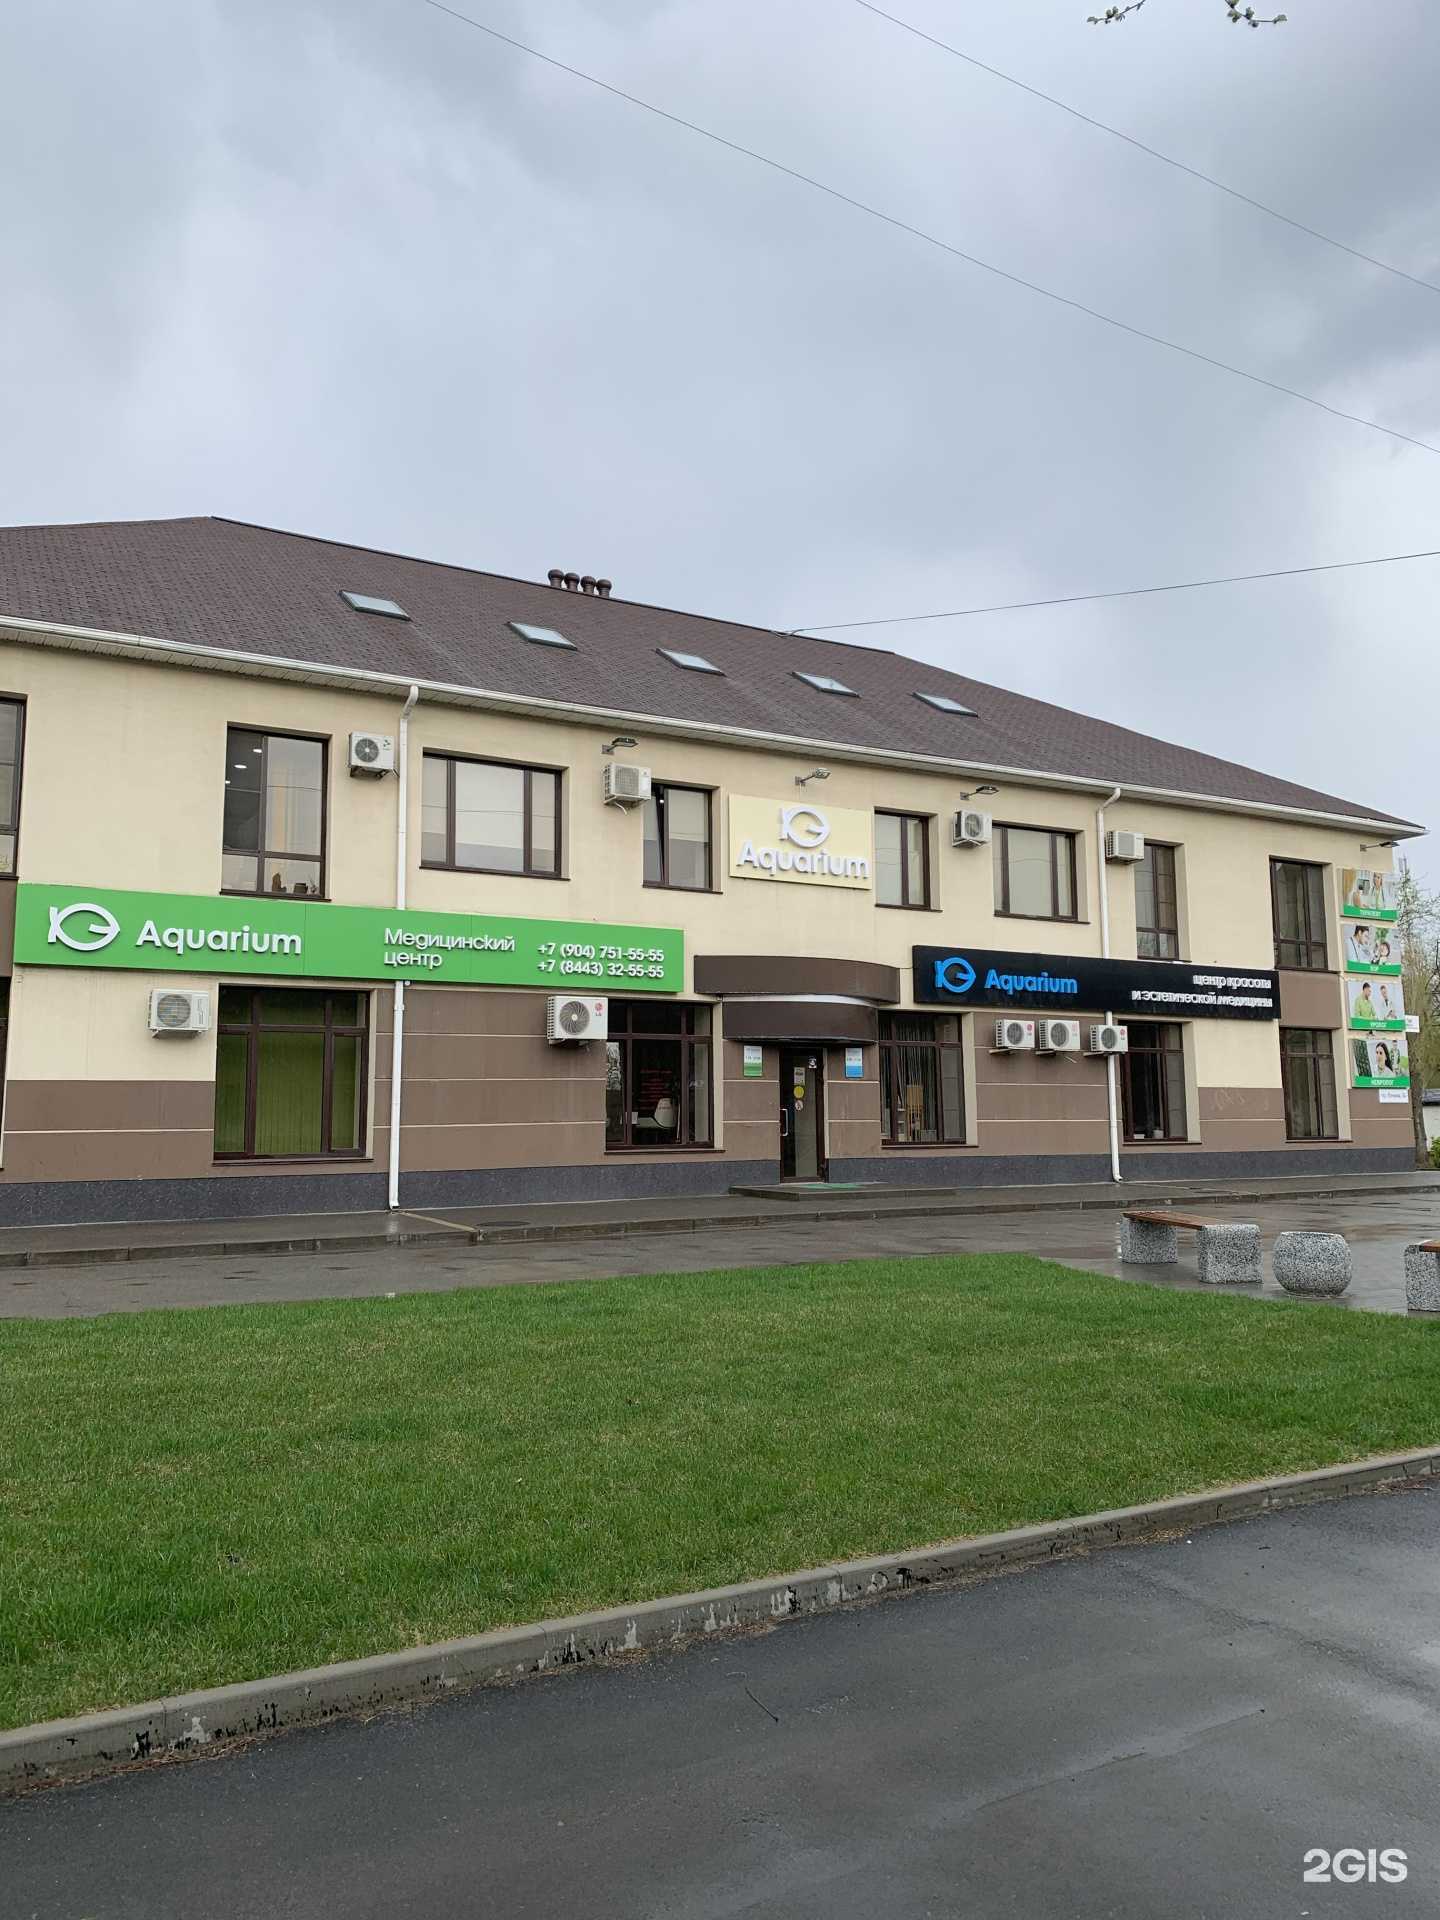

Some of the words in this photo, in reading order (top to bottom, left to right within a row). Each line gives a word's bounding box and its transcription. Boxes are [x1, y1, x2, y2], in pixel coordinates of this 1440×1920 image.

[737, 840, 870, 879] Aquarium
[136, 919, 302, 955] Aquarium
[384, 927, 516, 951] Медицинский
[384, 951, 443, 970] центр
[537, 942, 556, 956] +7
[560, 944, 596, 959] (904)
[599, 946, 665, 961] 751-55-55
[537, 959, 556, 972] +7
[560, 960, 604, 976] (8443)
[608, 963, 665, 978] 32-55-55
[984, 969, 1078, 995] Aquarium
[1193, 974, 1226, 988] центр
[1227, 977, 1272, 989] красоты
[1141, 991, 1216, 1004] эстетической
